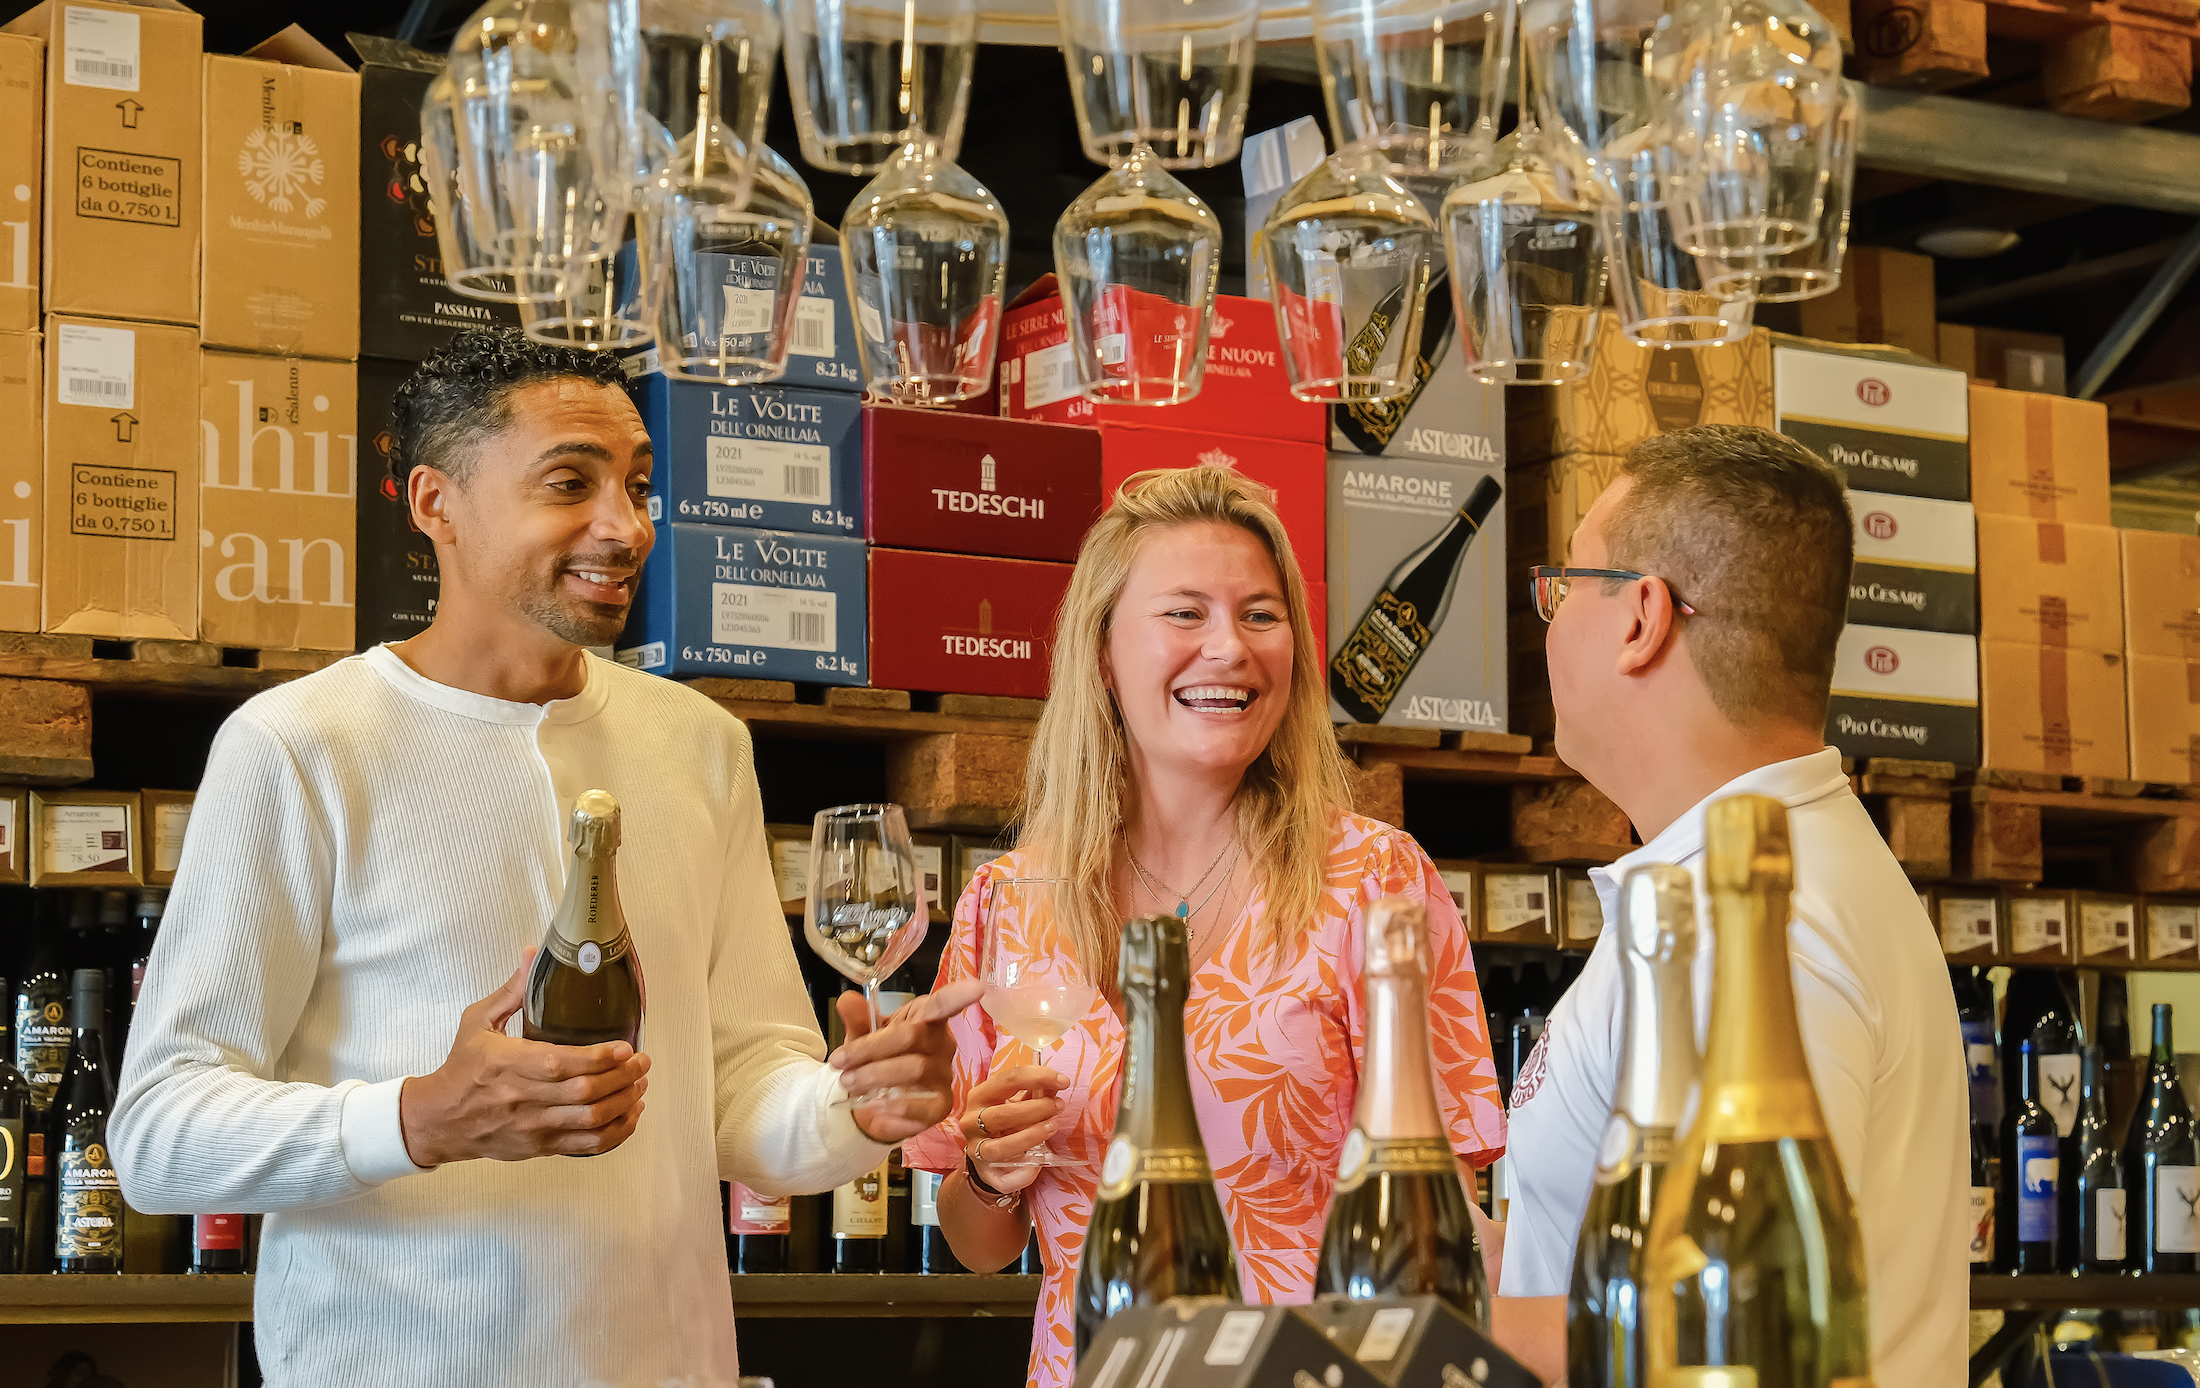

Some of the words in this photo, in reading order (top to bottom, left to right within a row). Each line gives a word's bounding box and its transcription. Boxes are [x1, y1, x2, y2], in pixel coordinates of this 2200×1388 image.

[82, 154, 164, 177] Contiene
[82, 175, 93, 189] 6
[98, 176, 174, 199] bottiglie
[81, 197, 103, 212] da
[107, 200, 160, 219] 0,750
[434, 301, 492, 320] PASSIATA
[1221, 346, 1277, 368] NUOVE
[815, 361, 838, 377] 8.2
[839, 362, 859, 382] kg
[710, 390, 740, 418] LE
[749, 394, 823, 424] VOLTE
[710, 419, 745, 437] DELL'
[745, 422, 822, 443] ORNELLAIA
[715, 446, 742, 460] 2021
[1403, 427, 1501, 463] ASTORIA
[76, 470, 159, 490] Contiene
[1342, 470, 1453, 498] AMARONE
[77, 492, 87, 506] 6
[93, 492, 168, 513] bottiglie
[931, 488, 1045, 519] TEDESCHI
[1342, 488, 1376, 500] DELLA
[1378, 492, 1453, 508] VALPOLICELLA
[679, 499, 691, 515] 6
[690, 504, 701, 516] x
[702, 501, 729, 517] 750
[730, 503, 747, 519] ml
[811, 509, 834, 525] 8.2
[837, 510, 854, 530] kg
[75, 515, 97, 530] da
[102, 517, 156, 534] 0,750
[714, 536, 744, 562] LE
[754, 538, 828, 568] VOLTE
[715, 565, 749, 581] DELL'
[750, 567, 827, 589] ORNELLAIA
[427, 598, 440, 612] P
[721, 592, 748, 606] 2021
[1374, 608, 1418, 653] AMARONE
[682, 645, 693, 660] 6
[694, 651, 704, 662] x
[706, 647, 733, 663] 750
[733, 650, 751, 665] ml
[941, 635, 1032, 660] TEDESCHI
[815, 655, 838, 671] 8.2
[841, 657, 858, 676] kg
[1401, 694, 1501, 727] ASTORIA
[64, 809, 101, 818] Amarone
[795, 882, 808, 892] 20
[587, 874, 600, 924] ROEDERER
[23, 1026, 73, 1036] AMARON
[32, 1073, 63, 1084] ASTOR
[64, 1168, 116, 1178] AMARON
[72, 1217, 114, 1228] ASTORIA
